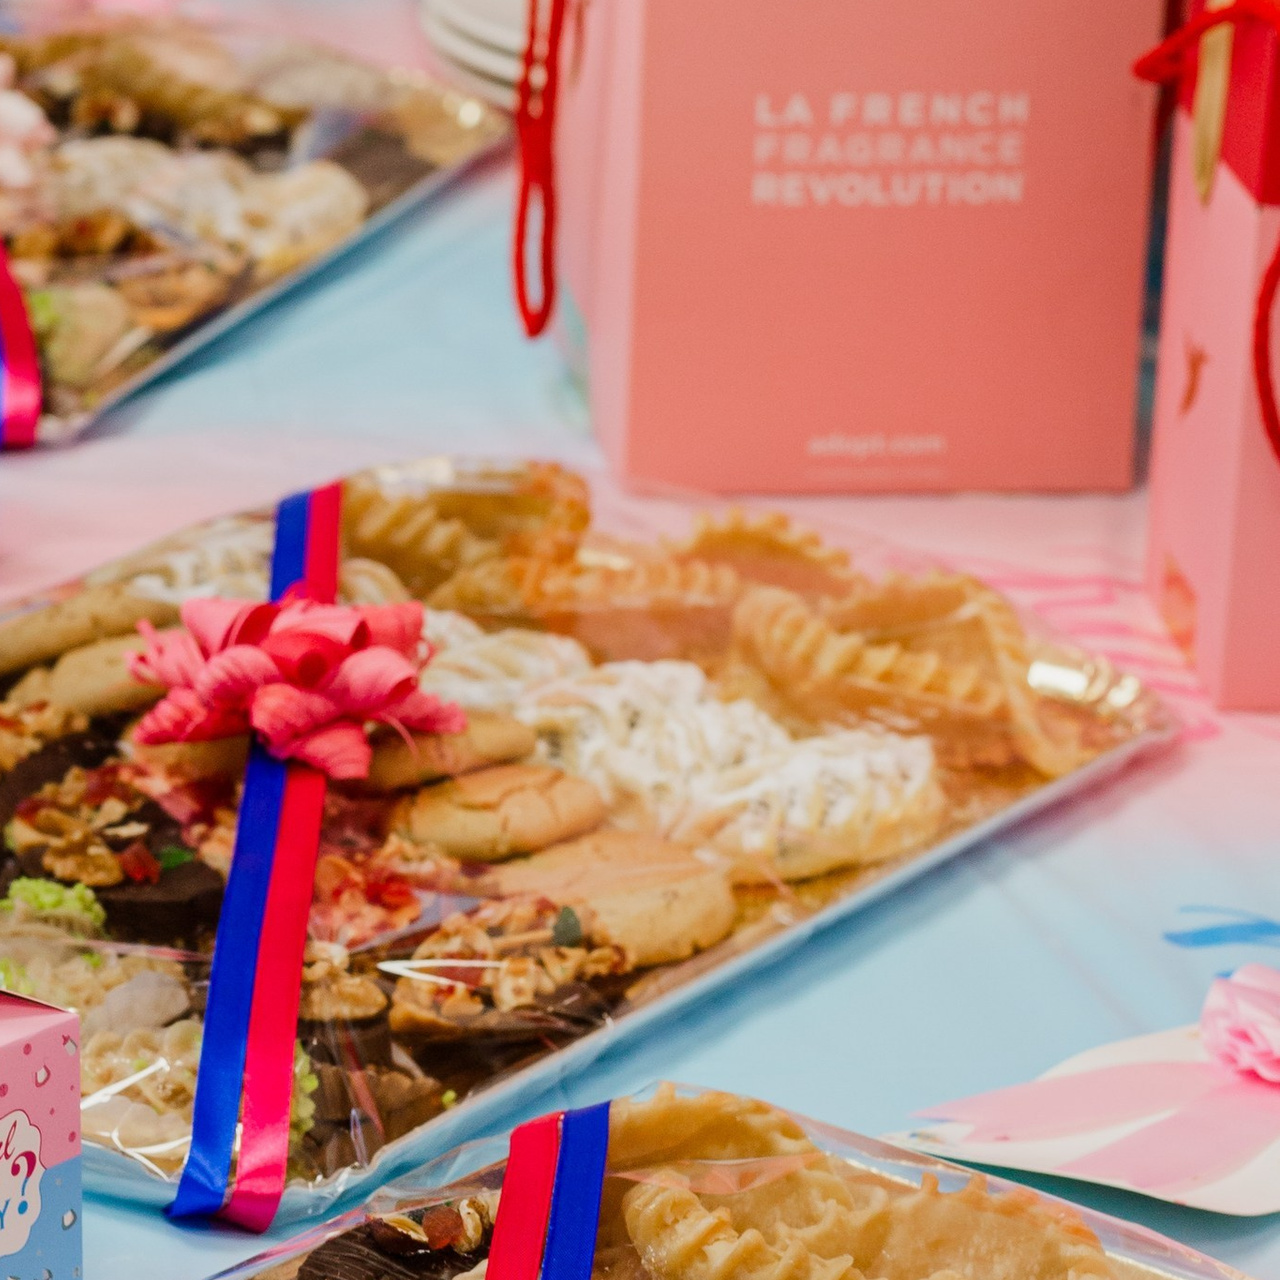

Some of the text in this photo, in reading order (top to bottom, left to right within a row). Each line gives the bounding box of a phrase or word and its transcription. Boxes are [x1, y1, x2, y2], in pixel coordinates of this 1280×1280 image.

[754, 91, 1028, 125] LA FRENCH
[753, 132, 1022, 164] FRAGRANCE
[751, 173, 1023, 207] REVOLUTION
